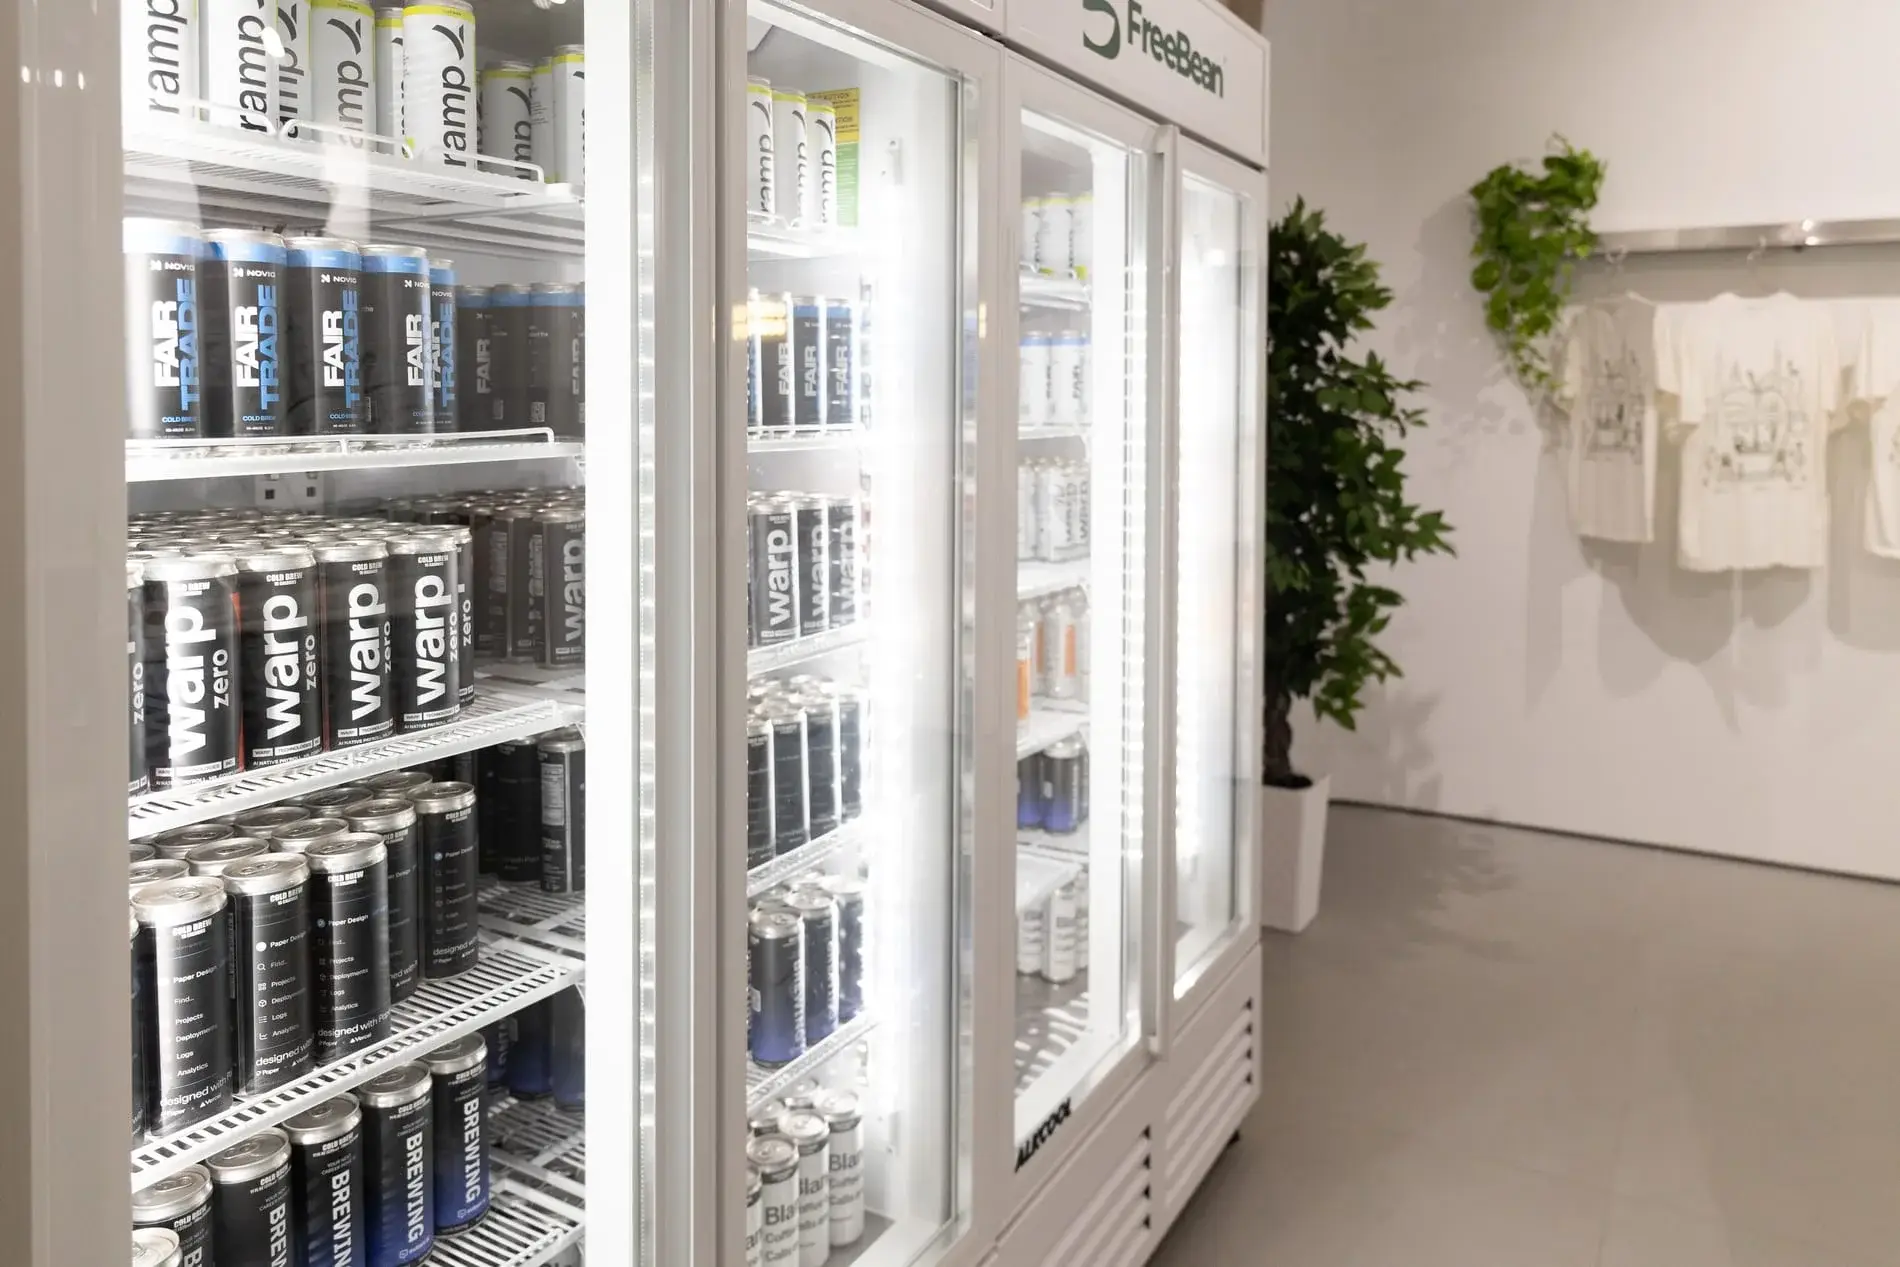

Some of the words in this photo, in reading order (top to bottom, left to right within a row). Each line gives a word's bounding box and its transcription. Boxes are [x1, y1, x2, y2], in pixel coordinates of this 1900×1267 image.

[147, 0, 188, 114] ramp
[1127, 0, 1224, 99] FreeBean
[441, 65, 471, 167] ramp
[152, 300, 180, 387] FAIR
[176, 278, 200, 411] TRADE
[234, 305, 260, 387] FAIR
[257, 284, 280, 410] TRADE
[322, 310, 345, 387] FAIR
[342, 289, 360, 408] TRADE
[405, 313, 424, 386] FAIR
[439, 302, 455, 407] TRADE
[476, 338, 491, 394] FAIR
[804, 345, 817, 397] FAIR
[266, 573, 284, 582] COLD
[352, 563, 368, 571] COLD
[417, 556, 434, 564] COLD
[767, 529, 793, 627] warp
[414, 575, 452, 706] warp
[449, 611, 458, 663] zero
[462, 599, 471, 647] zero
[212, 649, 230, 709] zero
[262, 594, 308, 740] warp
[305, 634, 317, 690] zero
[349, 583, 386, 721] warp
[132, 662, 145, 725] zero
[164, 605, 217, 759] warp
[192, 917, 213, 931] BREW
[269, 891, 288, 903] COLD
[347, 914, 369, 924] Design
[270, 937, 290, 948] Paper
[433, 941, 469, 956] designed
[173, 973, 195, 984] Paper
[271, 975, 296, 988] Projects
[175, 1012, 204, 1026] Projects
[271, 1011, 288, 1021] Logs
[318, 1023, 359, 1038] designed
[360, 1018, 378, 1030] with
[176, 1050, 194, 1061] Logs
[177, 1062, 209, 1077] Analytics
[255, 1046, 300, 1066] designed
[209, 1078, 227, 1093] with
[464, 1097, 481, 1203] BREWING
[406, 1131, 424, 1244] BREWING
[173, 1215, 192, 1228] COLD
